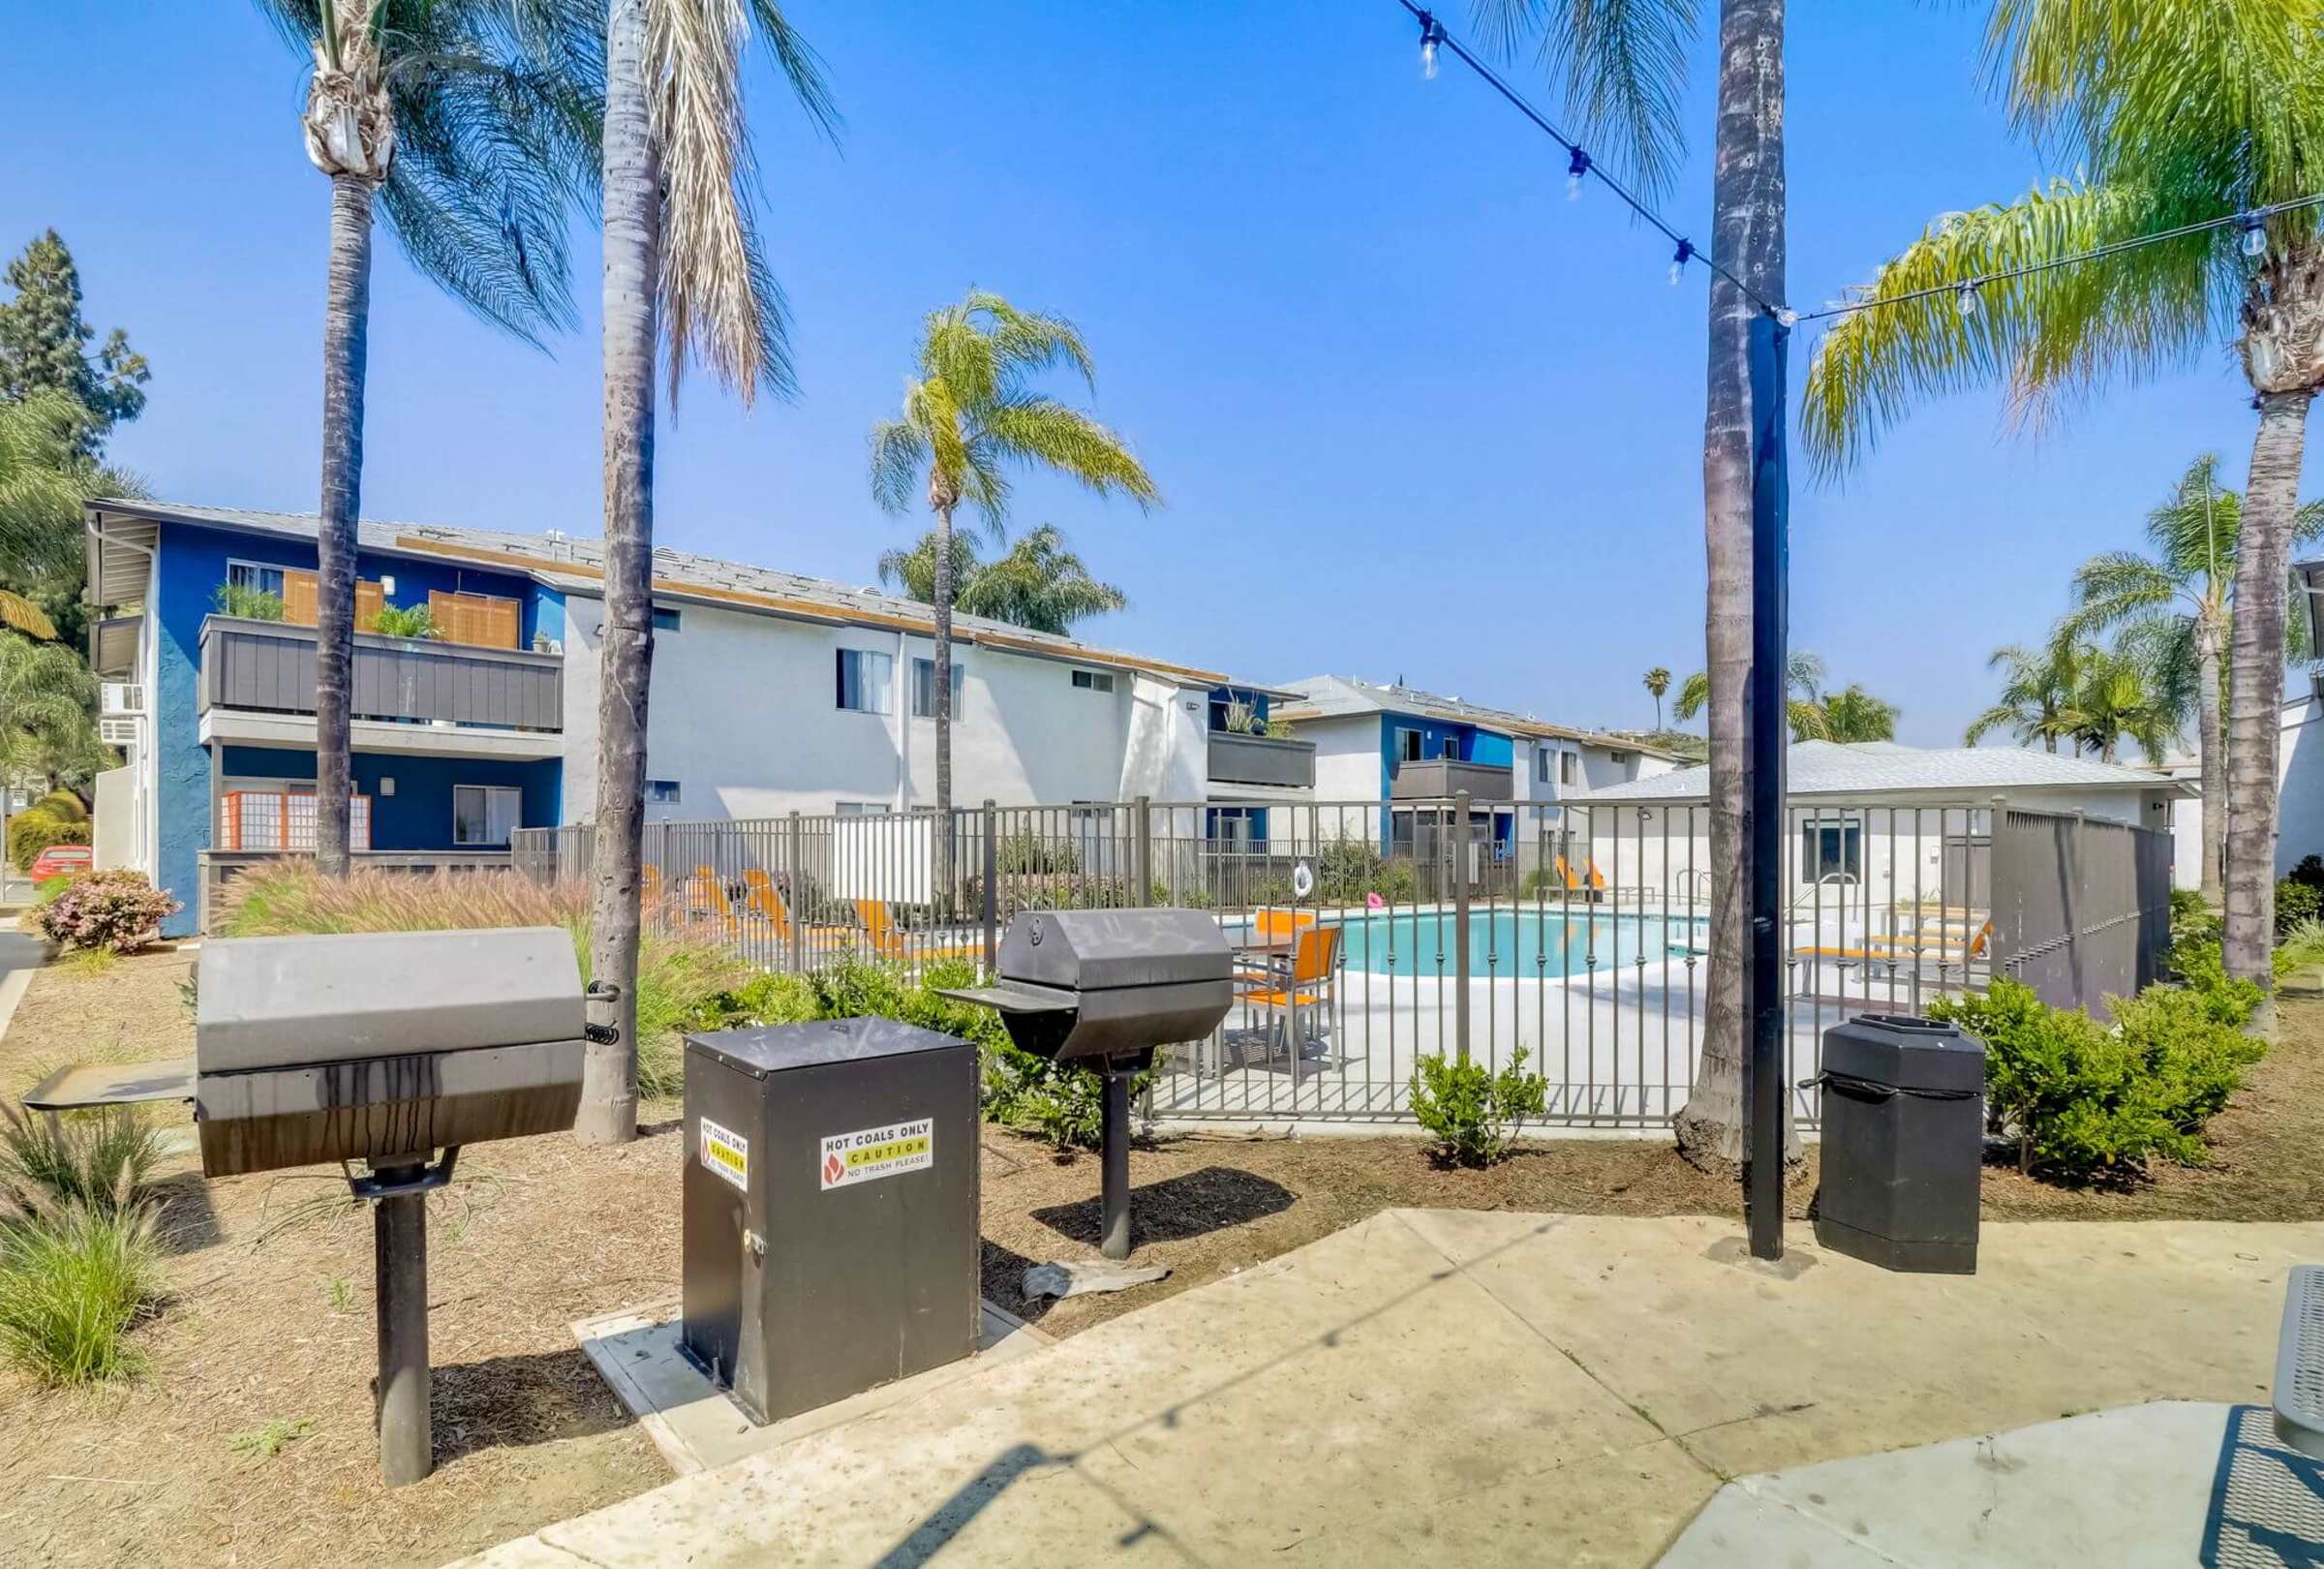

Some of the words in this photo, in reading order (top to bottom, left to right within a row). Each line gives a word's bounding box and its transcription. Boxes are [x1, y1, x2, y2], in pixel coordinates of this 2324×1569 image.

[826, 1138, 850, 1153] HOT
[856, 1129, 895, 1146] COALS
[900, 1123, 929, 1137] ONLY
[851, 1140, 925, 1163] CAUTION
[847, 1168, 861, 1179] NO
[864, 1161, 892, 1174] TRASH
